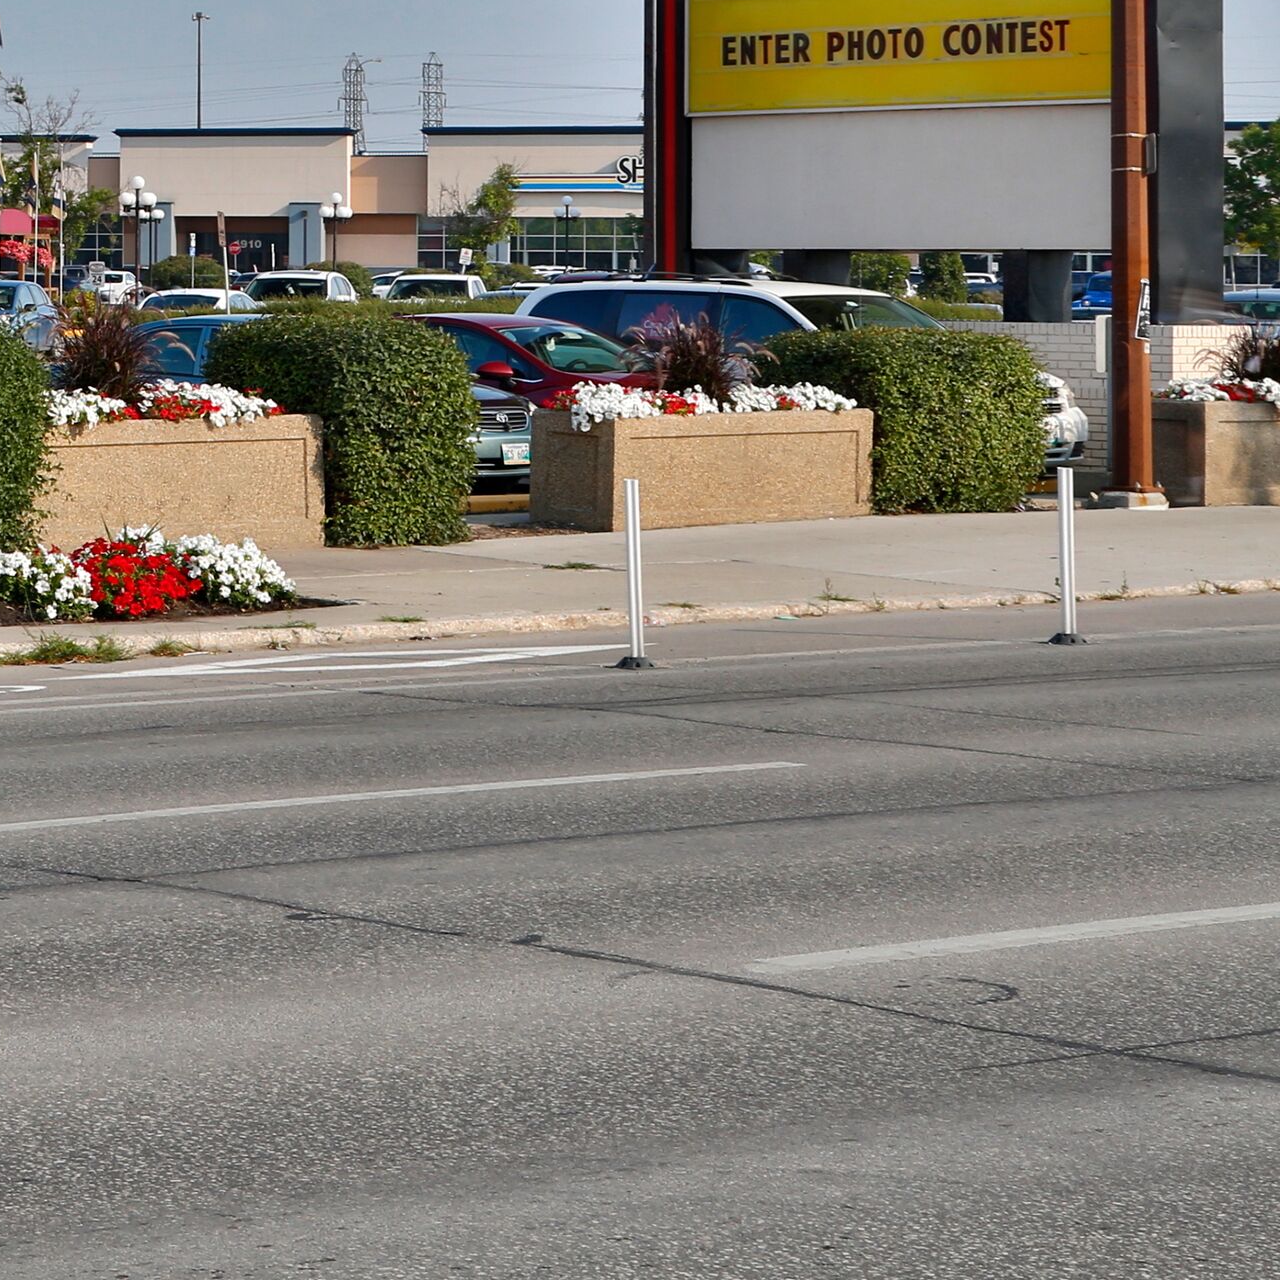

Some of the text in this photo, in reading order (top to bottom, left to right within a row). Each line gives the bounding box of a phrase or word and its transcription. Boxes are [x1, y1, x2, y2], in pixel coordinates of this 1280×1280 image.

[722, 20, 1071, 67] ENTER PHOTO CONTEST
